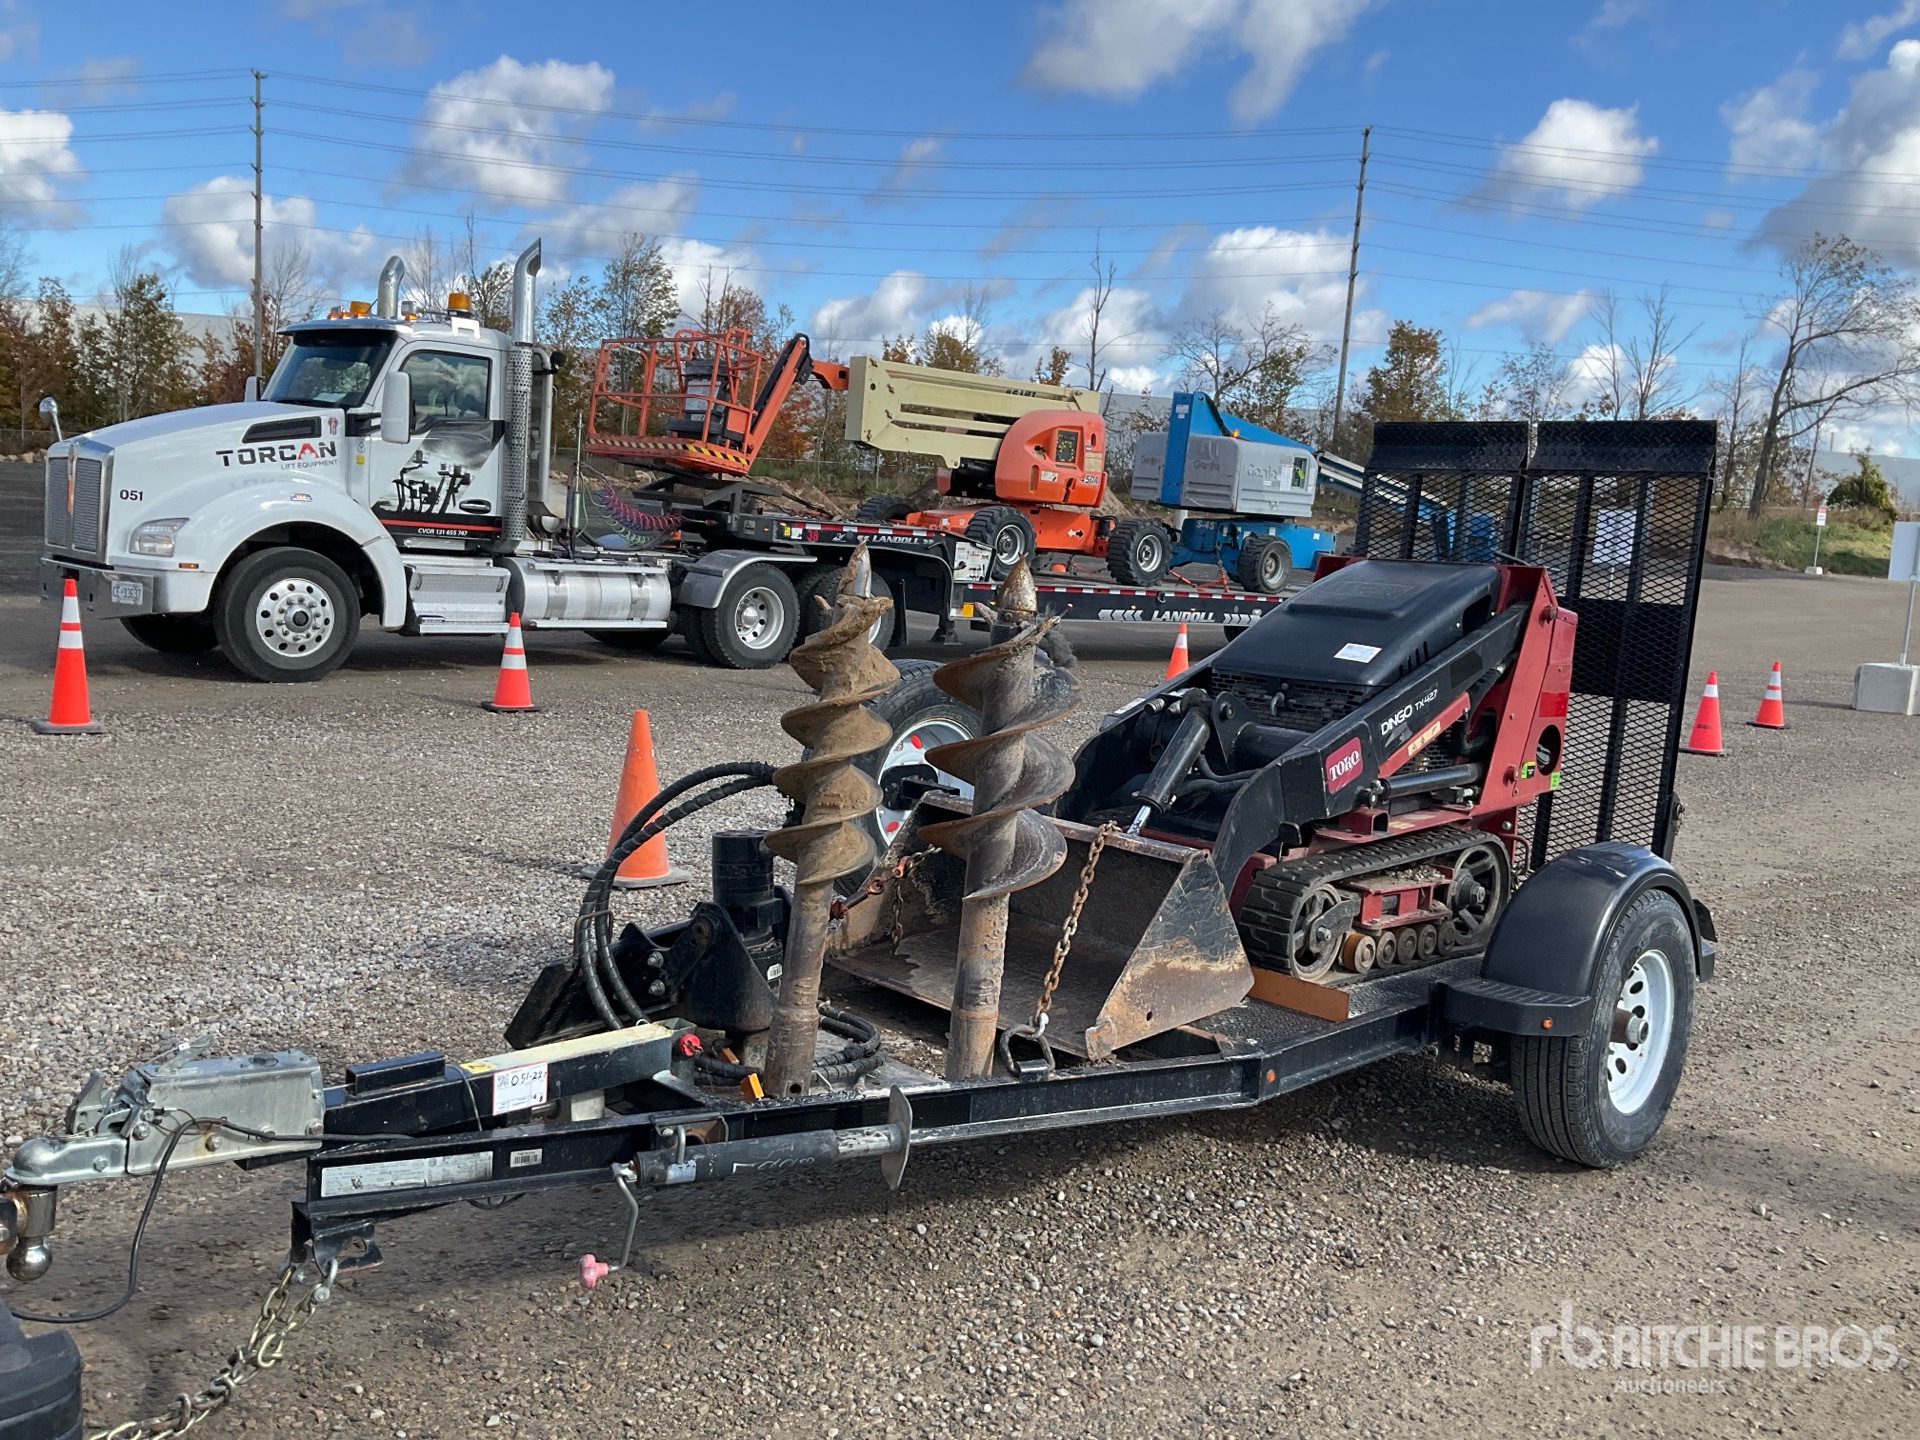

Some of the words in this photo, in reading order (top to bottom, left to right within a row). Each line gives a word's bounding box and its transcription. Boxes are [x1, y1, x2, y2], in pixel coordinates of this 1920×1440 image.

[215, 441, 337, 467] TORCAN
[281, 462, 295, 470] LIFT
[297, 459, 338, 469] EQUIPMENT
[120, 489, 143, 501] 051
[872, 534, 920, 545] LANDOLL
[1150, 610, 1215, 623] LANDOLL
[1381, 704, 1413, 735] DINGO
[1328, 750, 1360, 781] TORO
